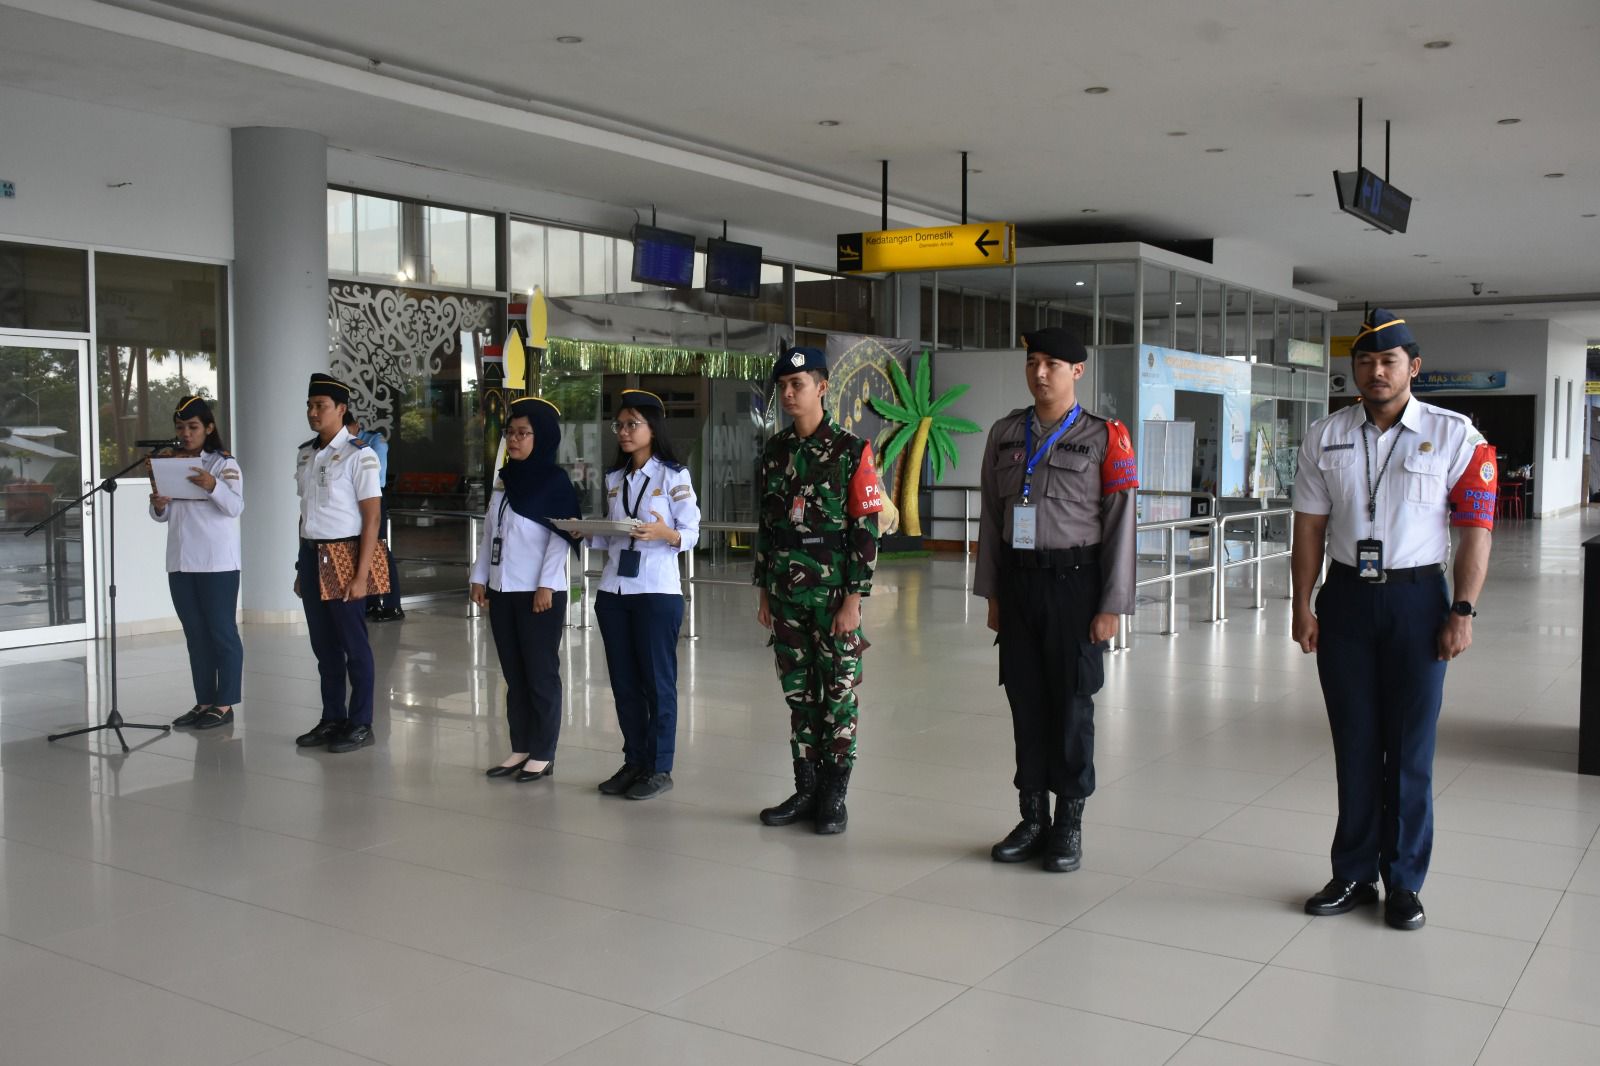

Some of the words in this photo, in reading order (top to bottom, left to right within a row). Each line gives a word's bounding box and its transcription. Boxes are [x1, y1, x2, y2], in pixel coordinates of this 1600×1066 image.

[866, 235, 912, 245] Kedatangan
[915, 230, 954, 242] Domestik
[1056, 442, 1090, 455] POLRI
